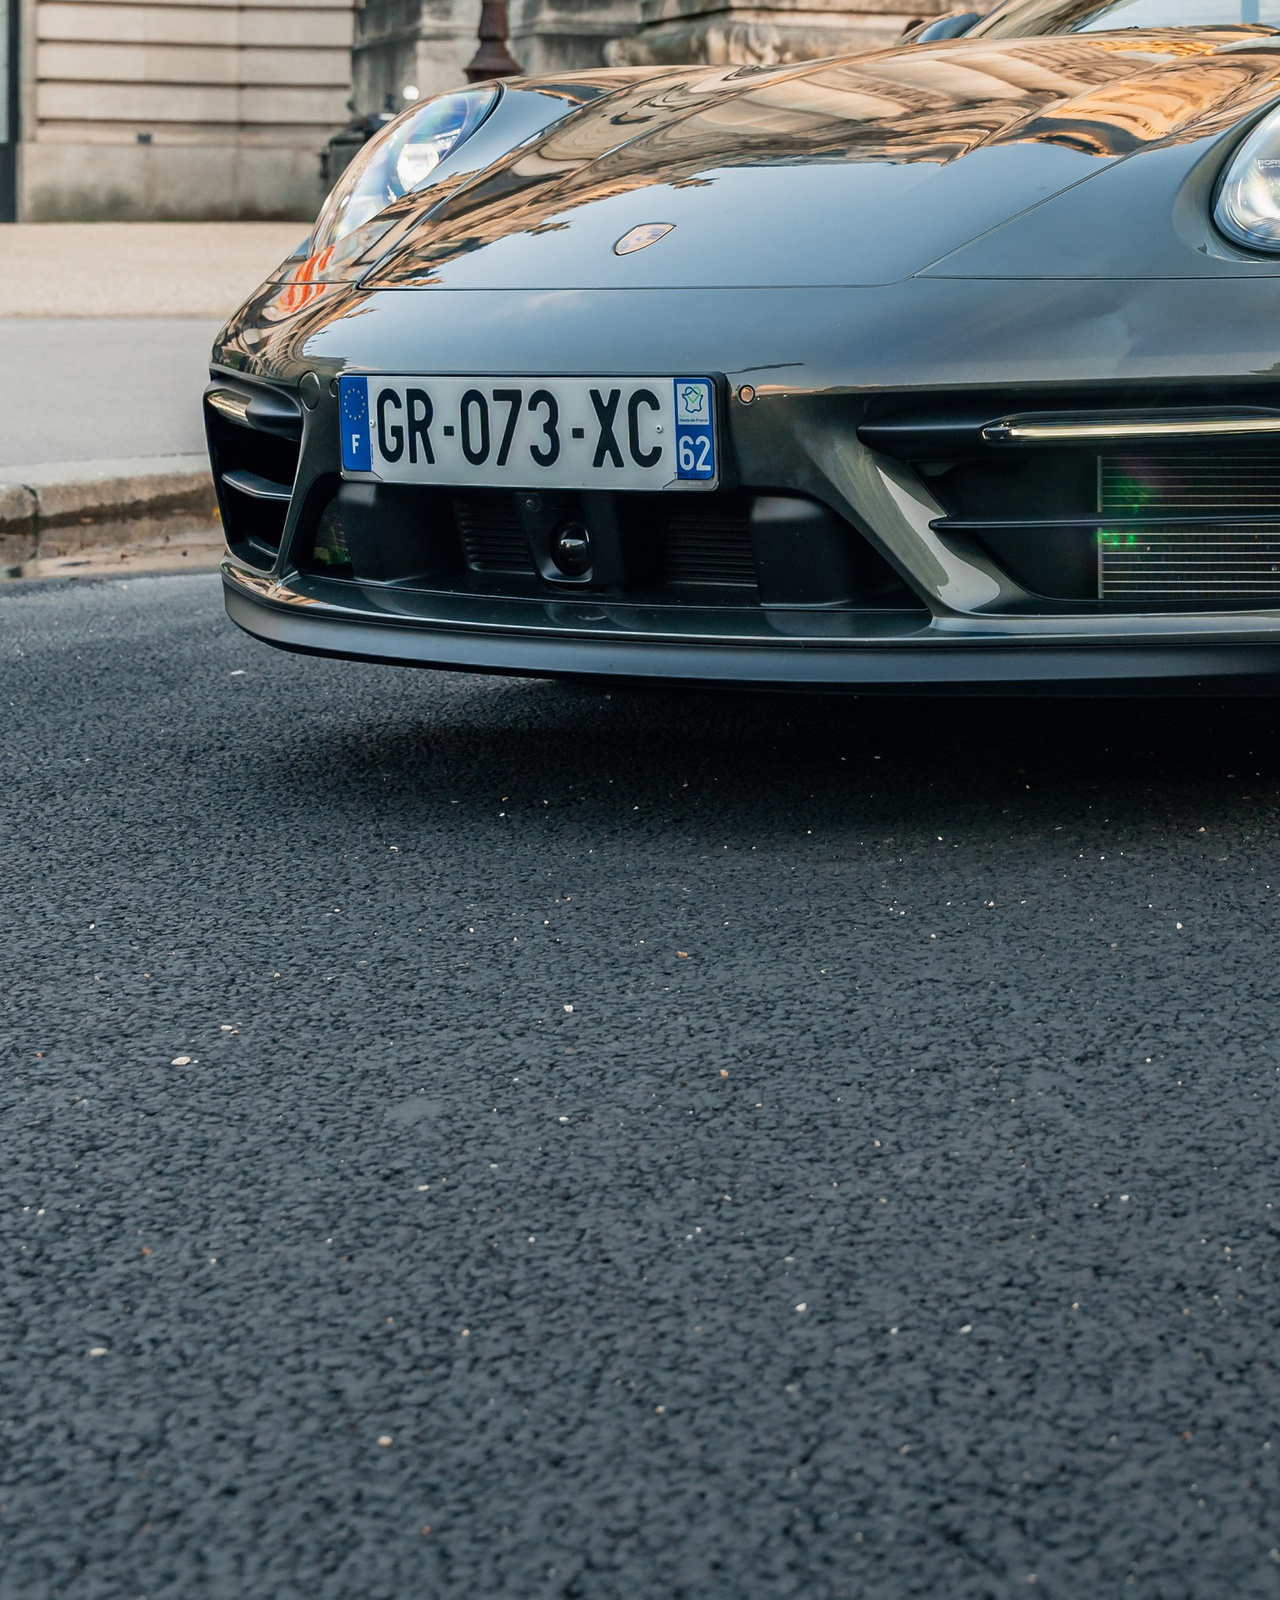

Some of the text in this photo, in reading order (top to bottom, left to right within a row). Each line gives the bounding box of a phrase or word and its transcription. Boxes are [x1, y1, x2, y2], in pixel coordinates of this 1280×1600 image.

[351, 433, 361, 455] F
[376, 387, 663, 469] GR-073-XC
[679, 435, 712, 471] 62
